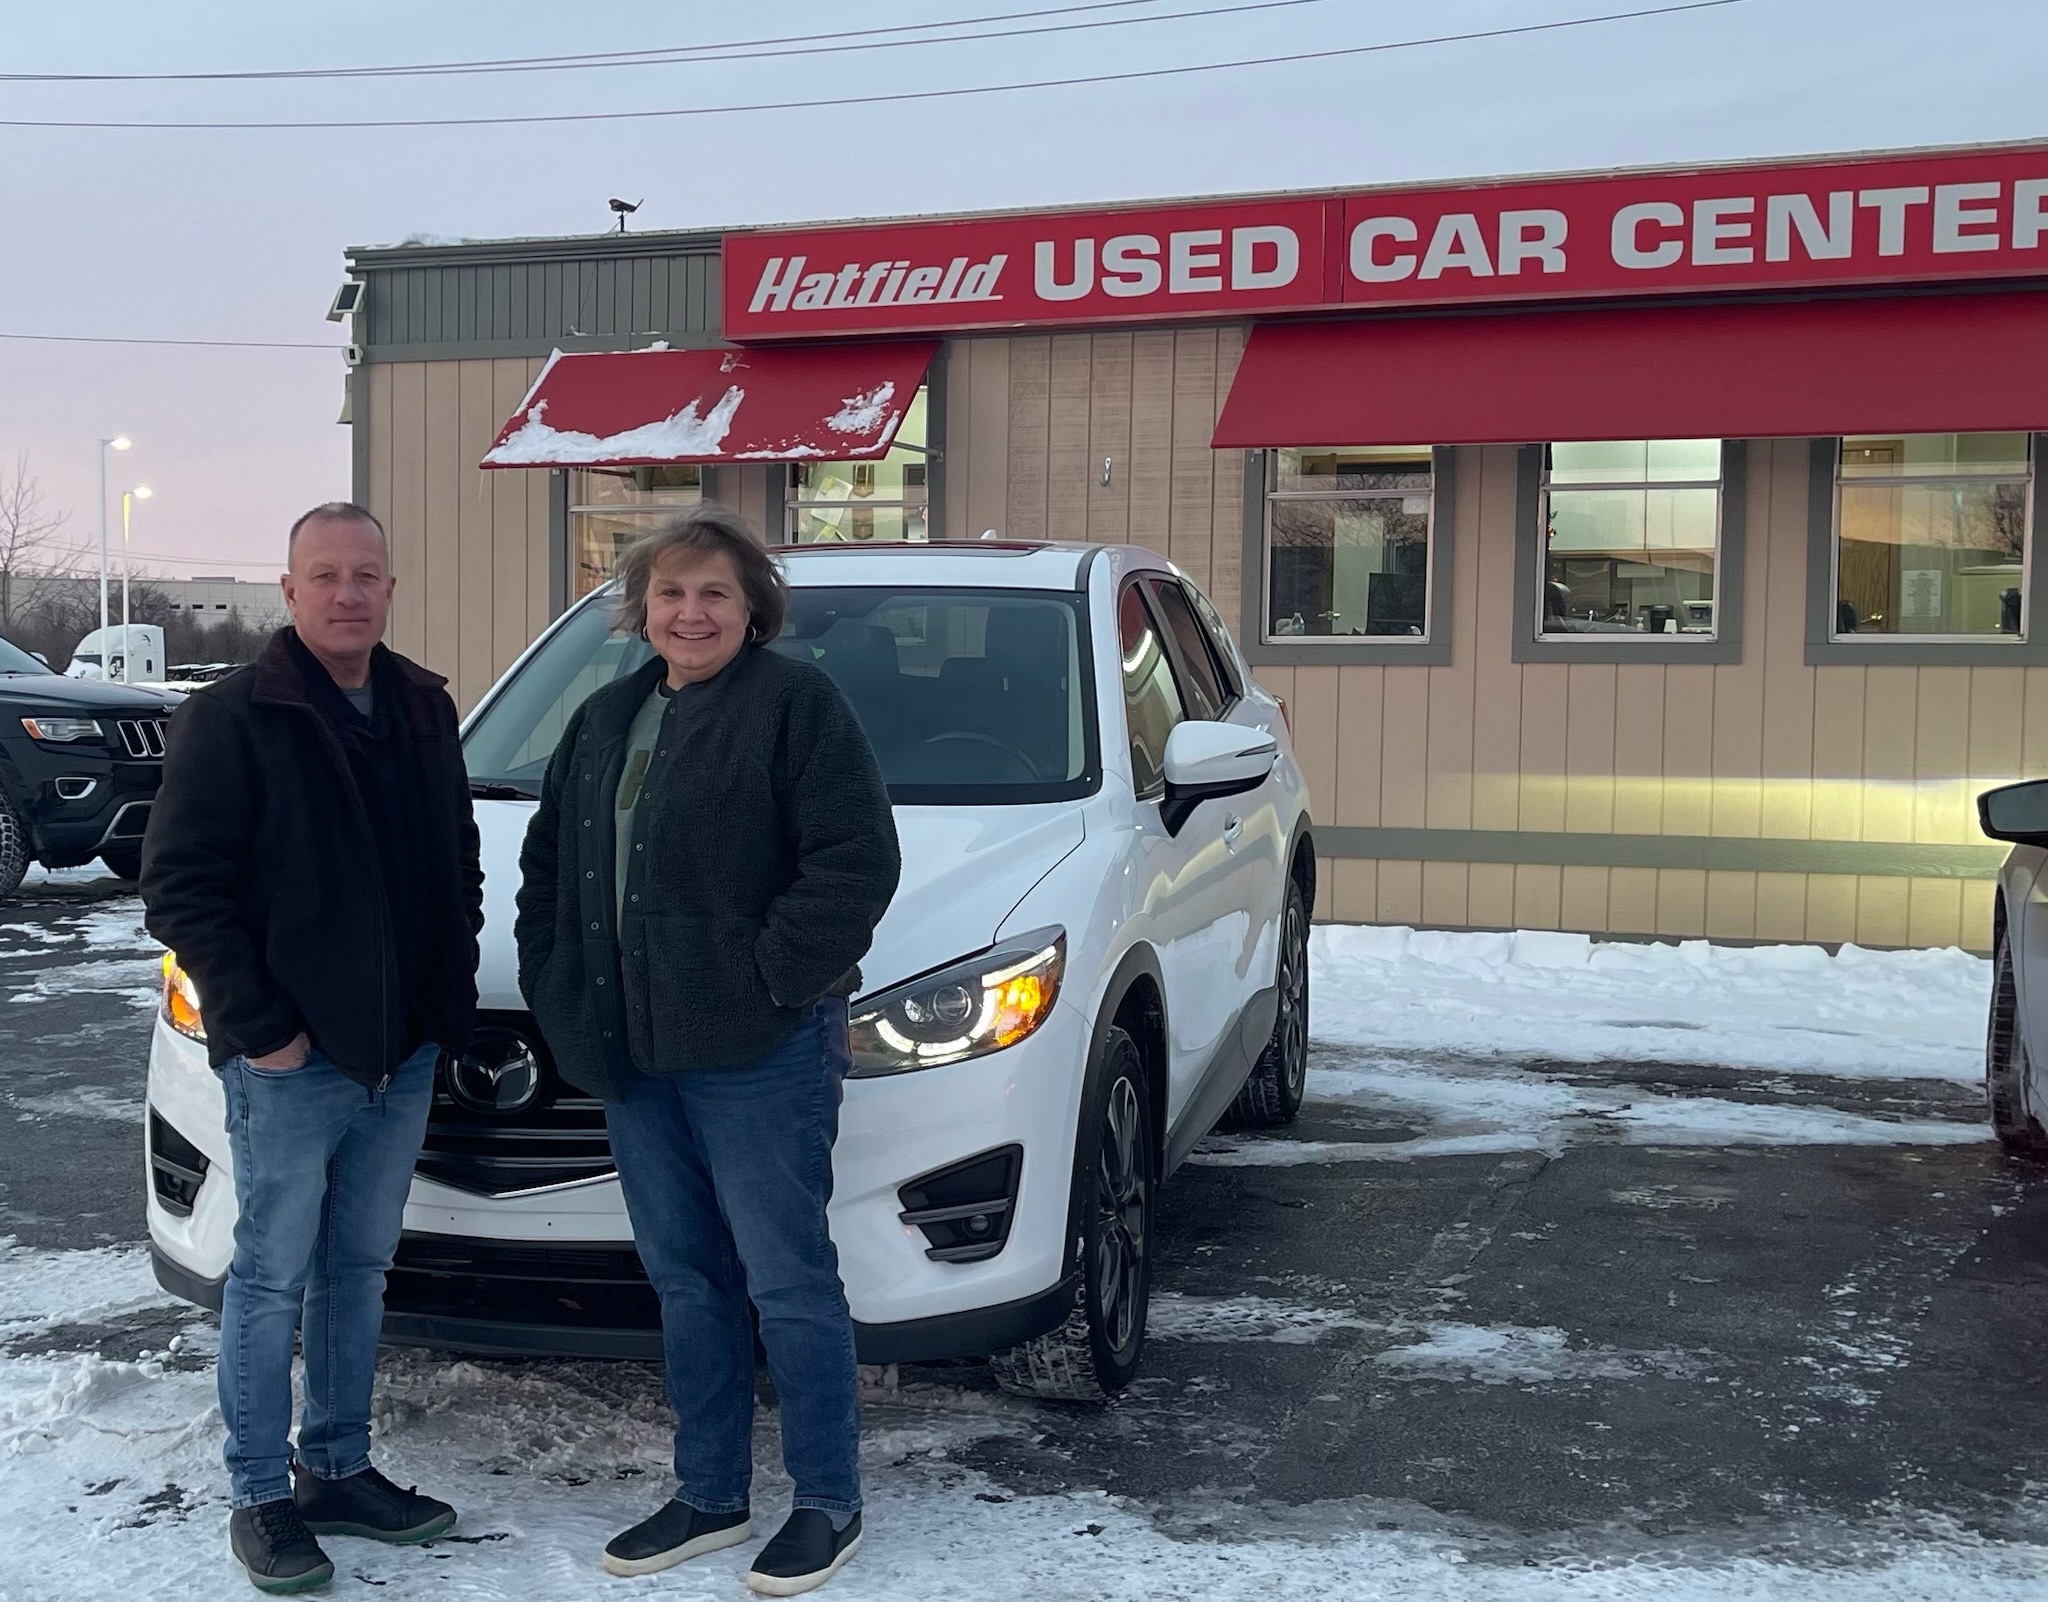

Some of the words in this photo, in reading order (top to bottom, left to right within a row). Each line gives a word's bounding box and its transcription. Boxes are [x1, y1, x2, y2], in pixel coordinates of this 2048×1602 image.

[747, 254, 1008, 313] Hatfield
[1034, 225, 1300, 301] USED
[1349, 209, 1569, 283] CAR
